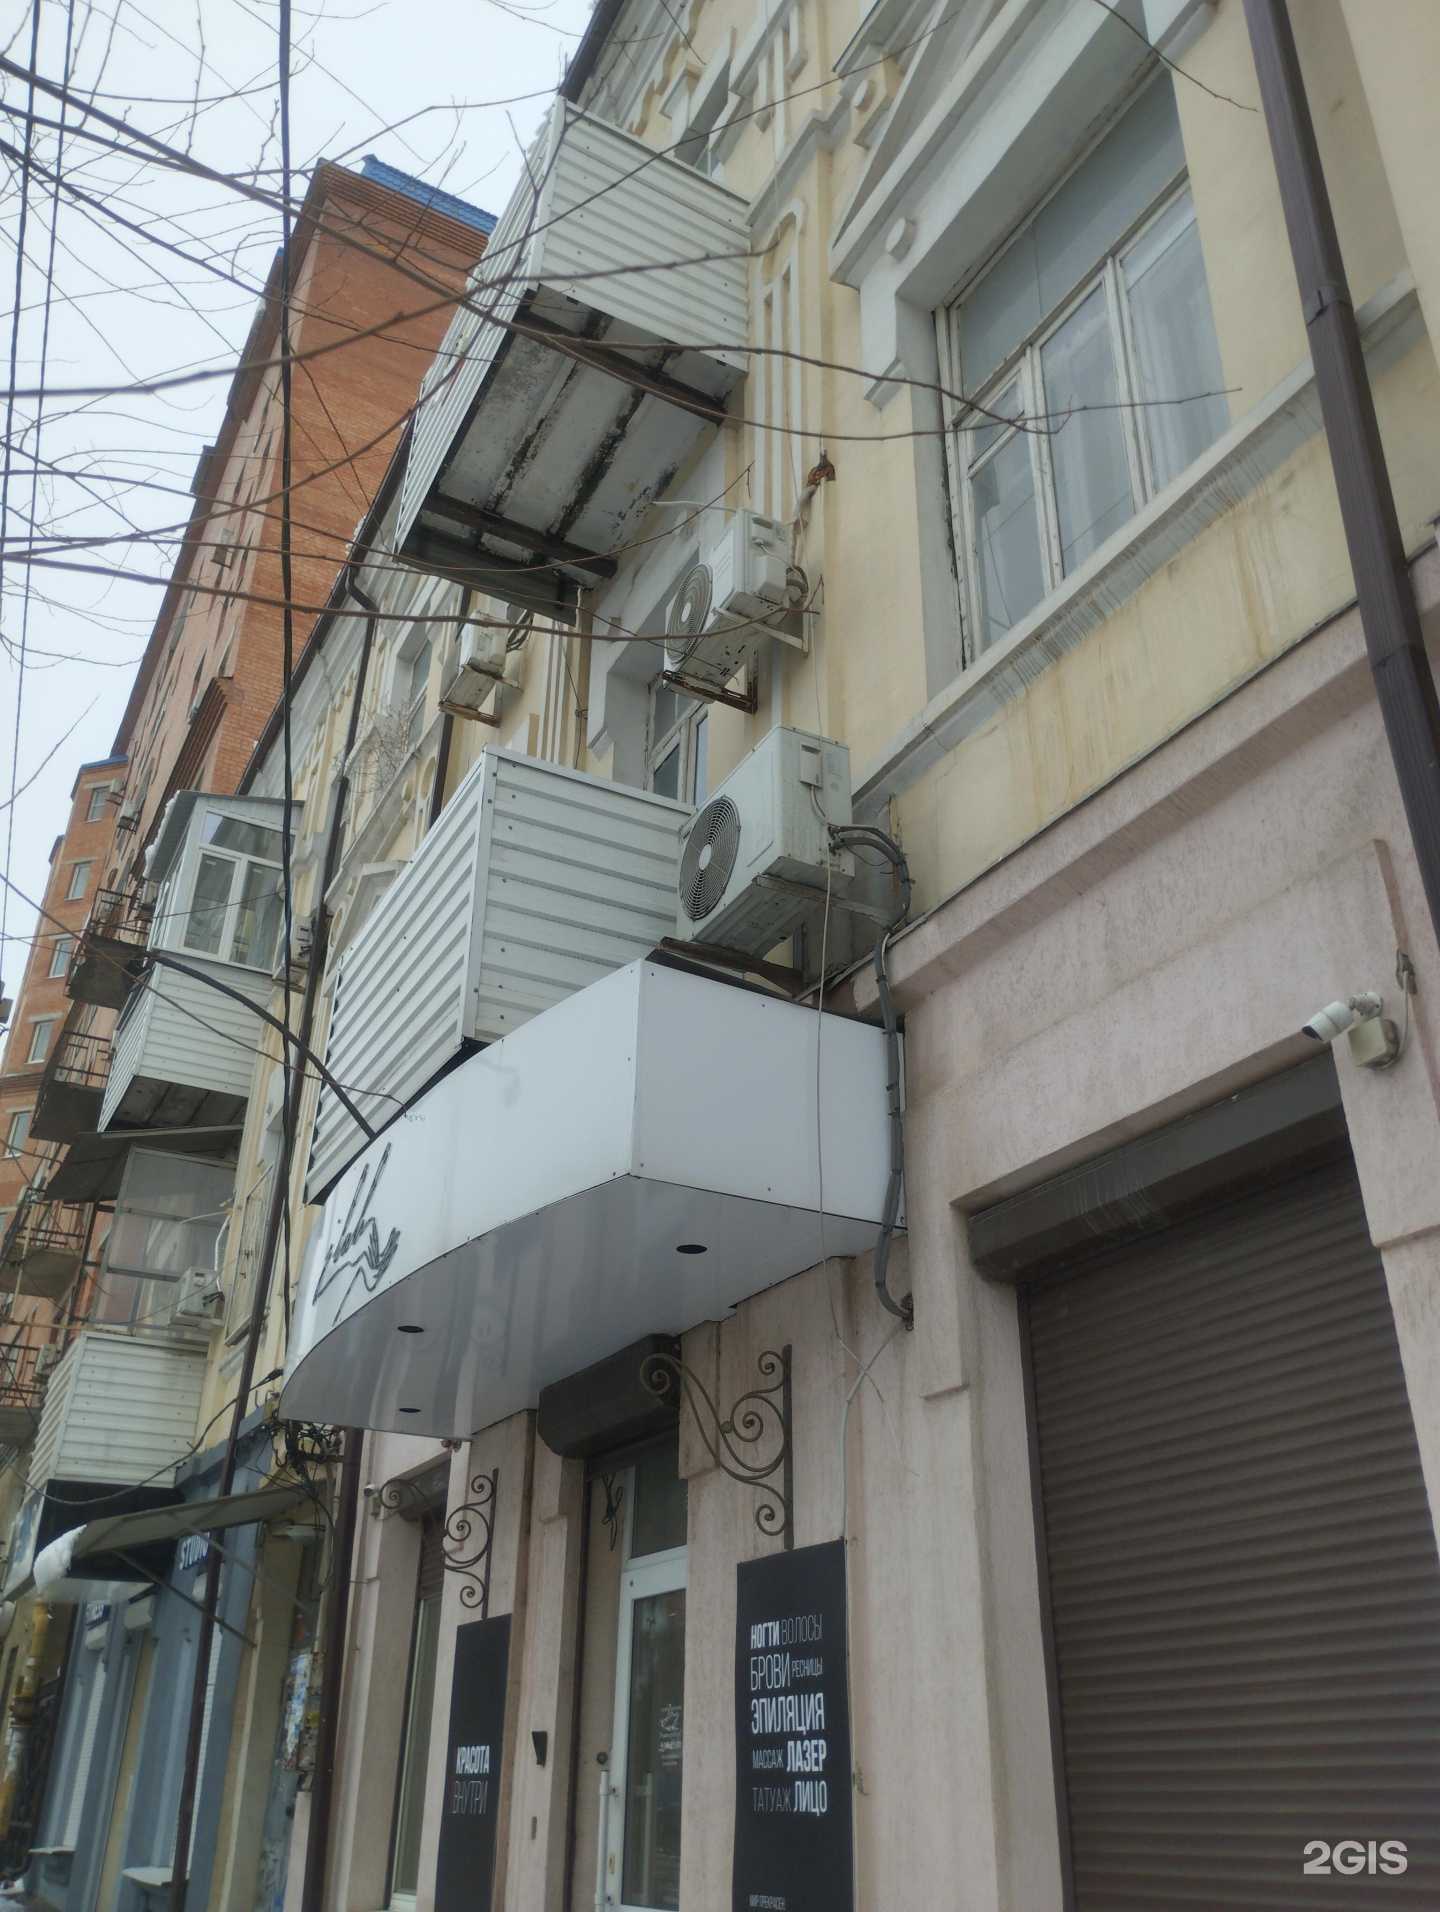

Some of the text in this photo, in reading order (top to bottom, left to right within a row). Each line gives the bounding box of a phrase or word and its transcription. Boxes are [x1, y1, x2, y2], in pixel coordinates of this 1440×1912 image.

[750, 1614, 823, 1650] НОГТИ ВОЛОСЫ
[750, 1652, 824, 1691] БРОВИ РЕСНИЦЫ
[751, 1692, 825, 1736] ЭПИЛЯЦИЯ
[456, 1745, 490, 1774] КРАСОТА
[752, 1739, 827, 1772] МАССАЖ ЛАЗЕР
[752, 1780, 828, 1816] ТАТУАЖ ЛИЦО
